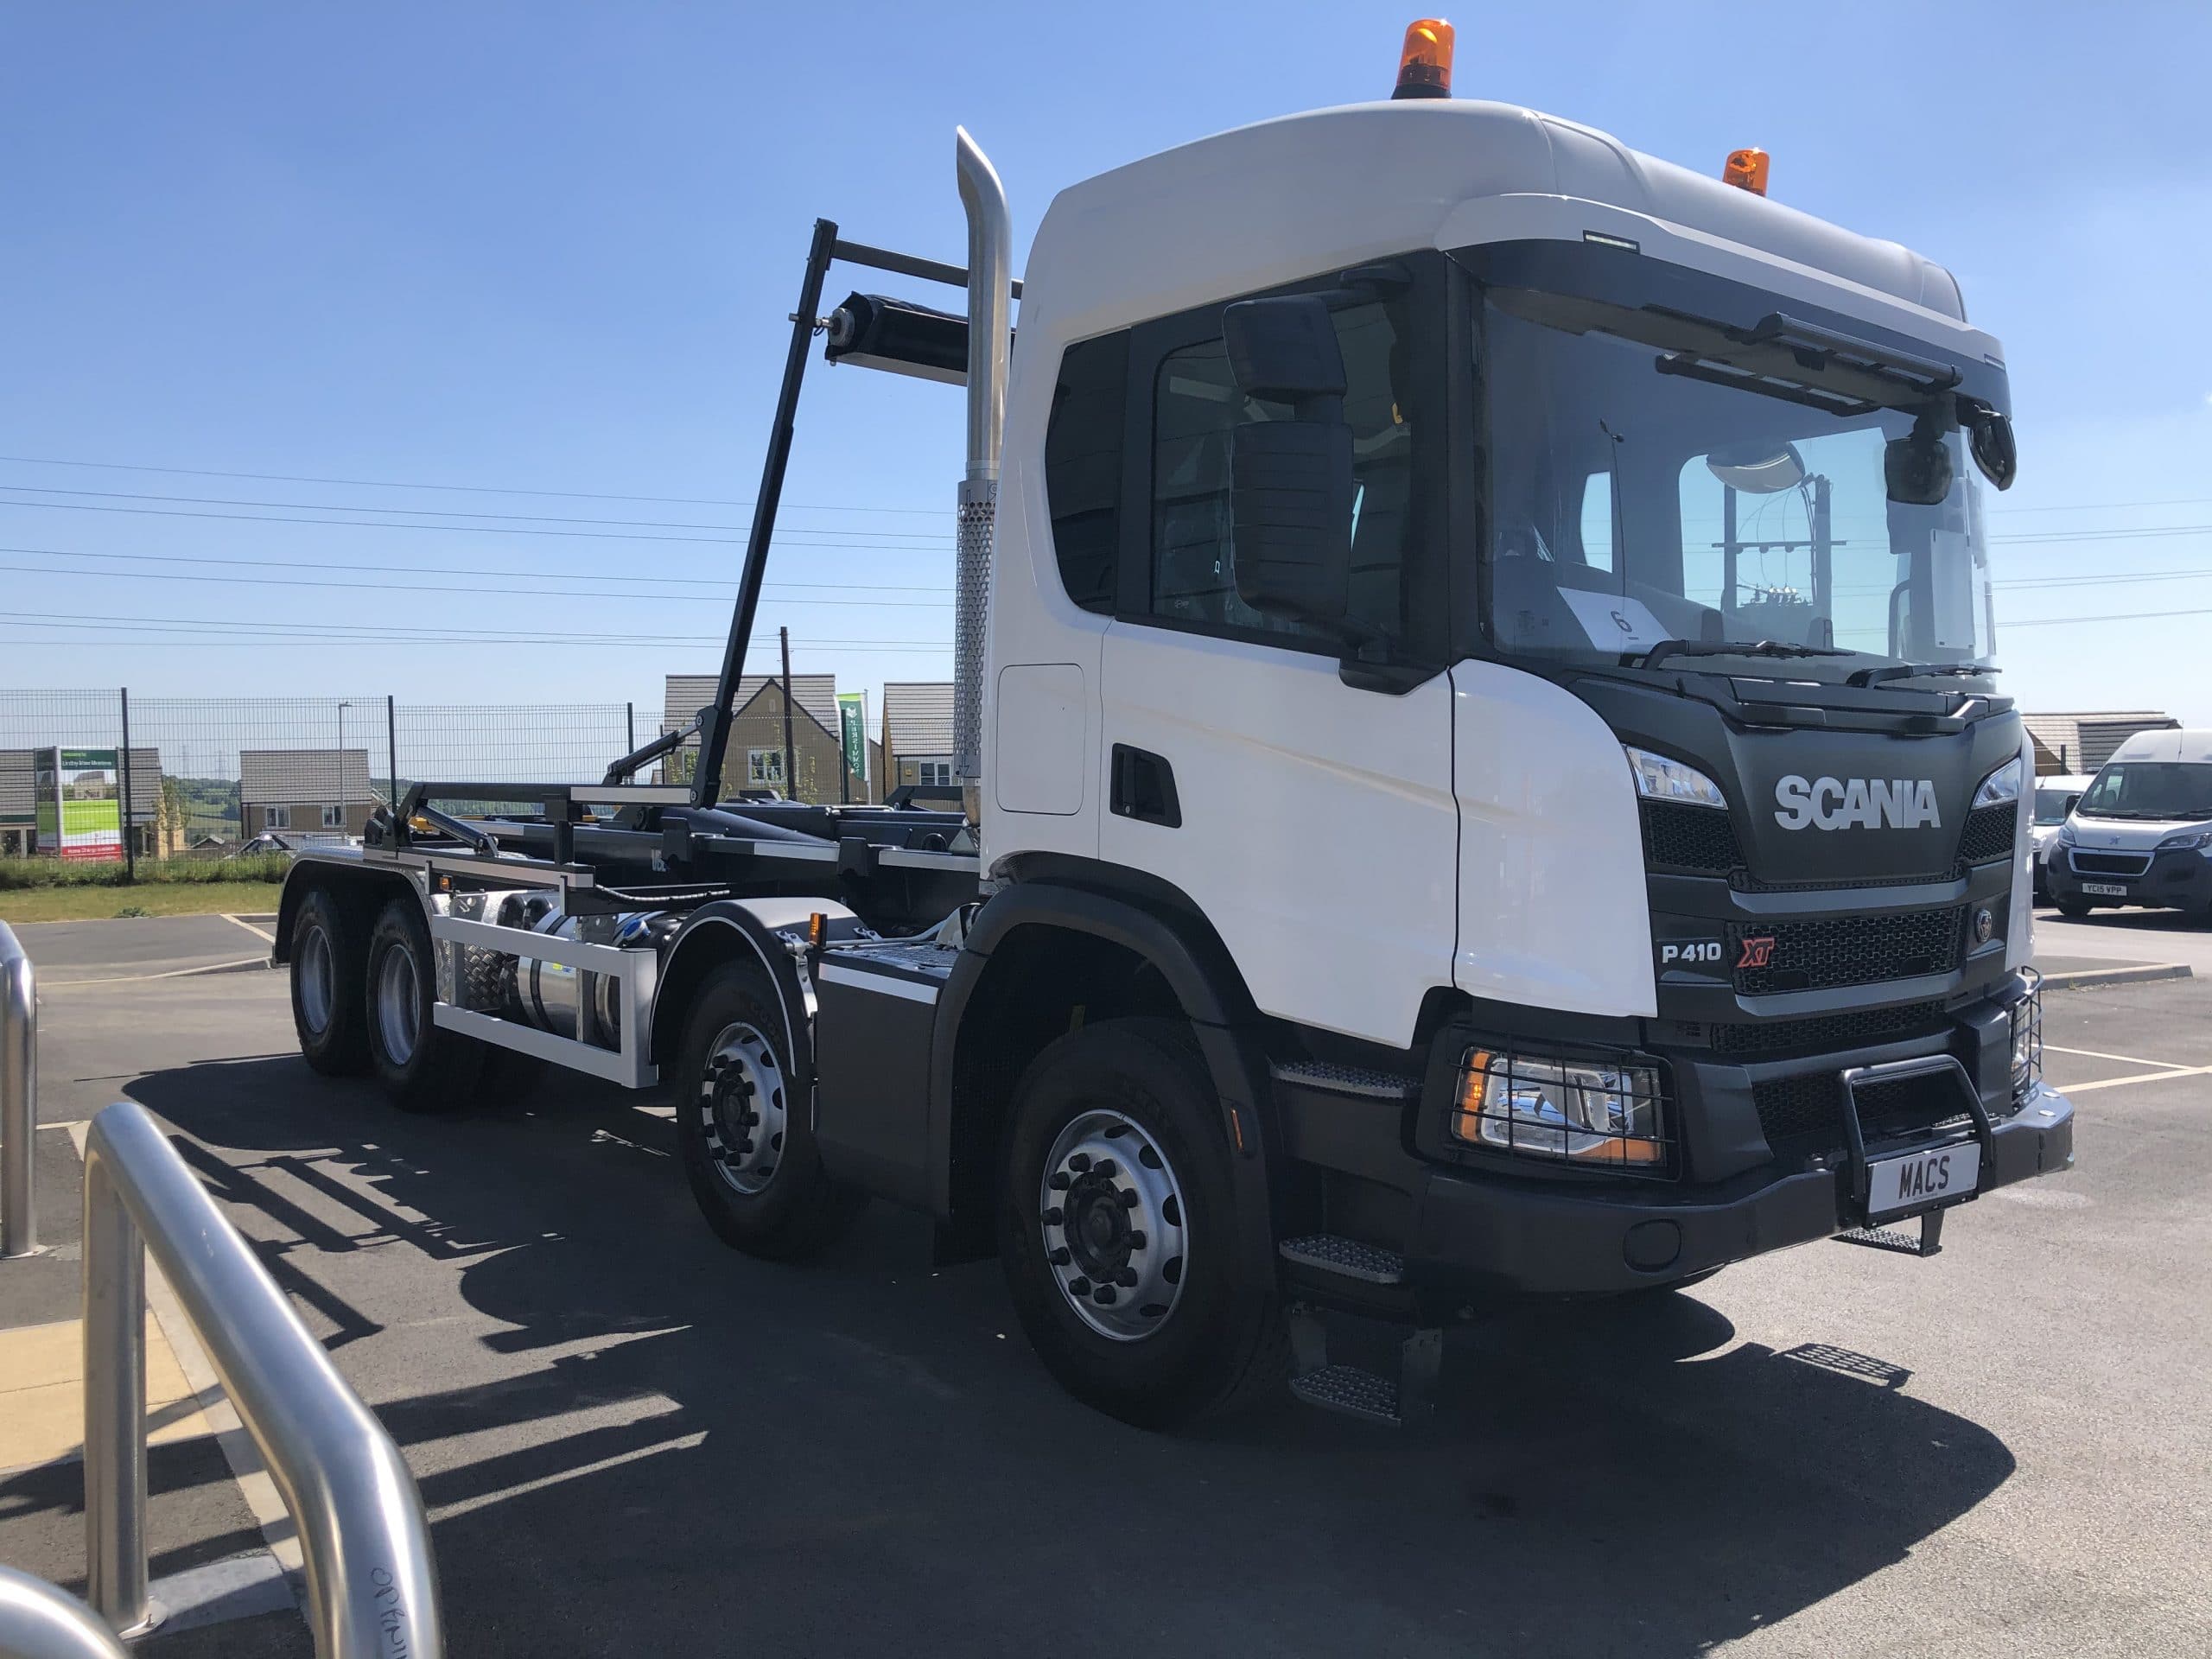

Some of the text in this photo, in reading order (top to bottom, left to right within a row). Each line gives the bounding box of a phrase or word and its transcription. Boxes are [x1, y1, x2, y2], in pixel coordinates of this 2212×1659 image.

[1611, 610, 1633, 632] 6
[1774, 774, 1942, 830] SCANIA
[2088, 884, 2104, 893] YC15
[1662, 943, 1722, 963] P 410
[1737, 937, 1775, 968] XT
[1899, 1155, 1951, 1199] MACS
